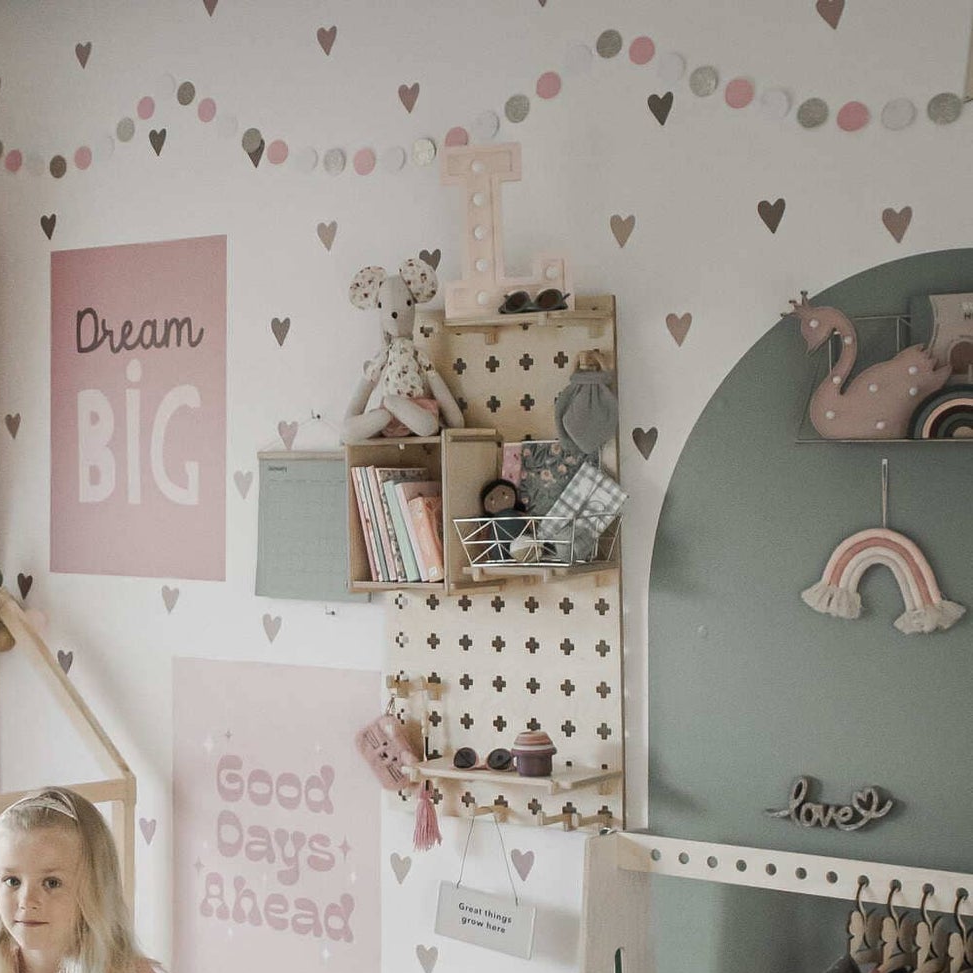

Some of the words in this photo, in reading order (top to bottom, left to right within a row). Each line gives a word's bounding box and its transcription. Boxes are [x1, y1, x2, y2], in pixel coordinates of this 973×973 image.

[77, 307, 204, 354] Dream
[217, 754, 335, 815] Good
[767, 777, 893, 831] love
[217, 810, 336, 886] Days
[200, 871, 355, 943] Ahead
[458, 902, 482, 915] Great
[485, 910, 512, 923] things
[461, 916, 484, 927] grow
[486, 922, 506, 933] here
